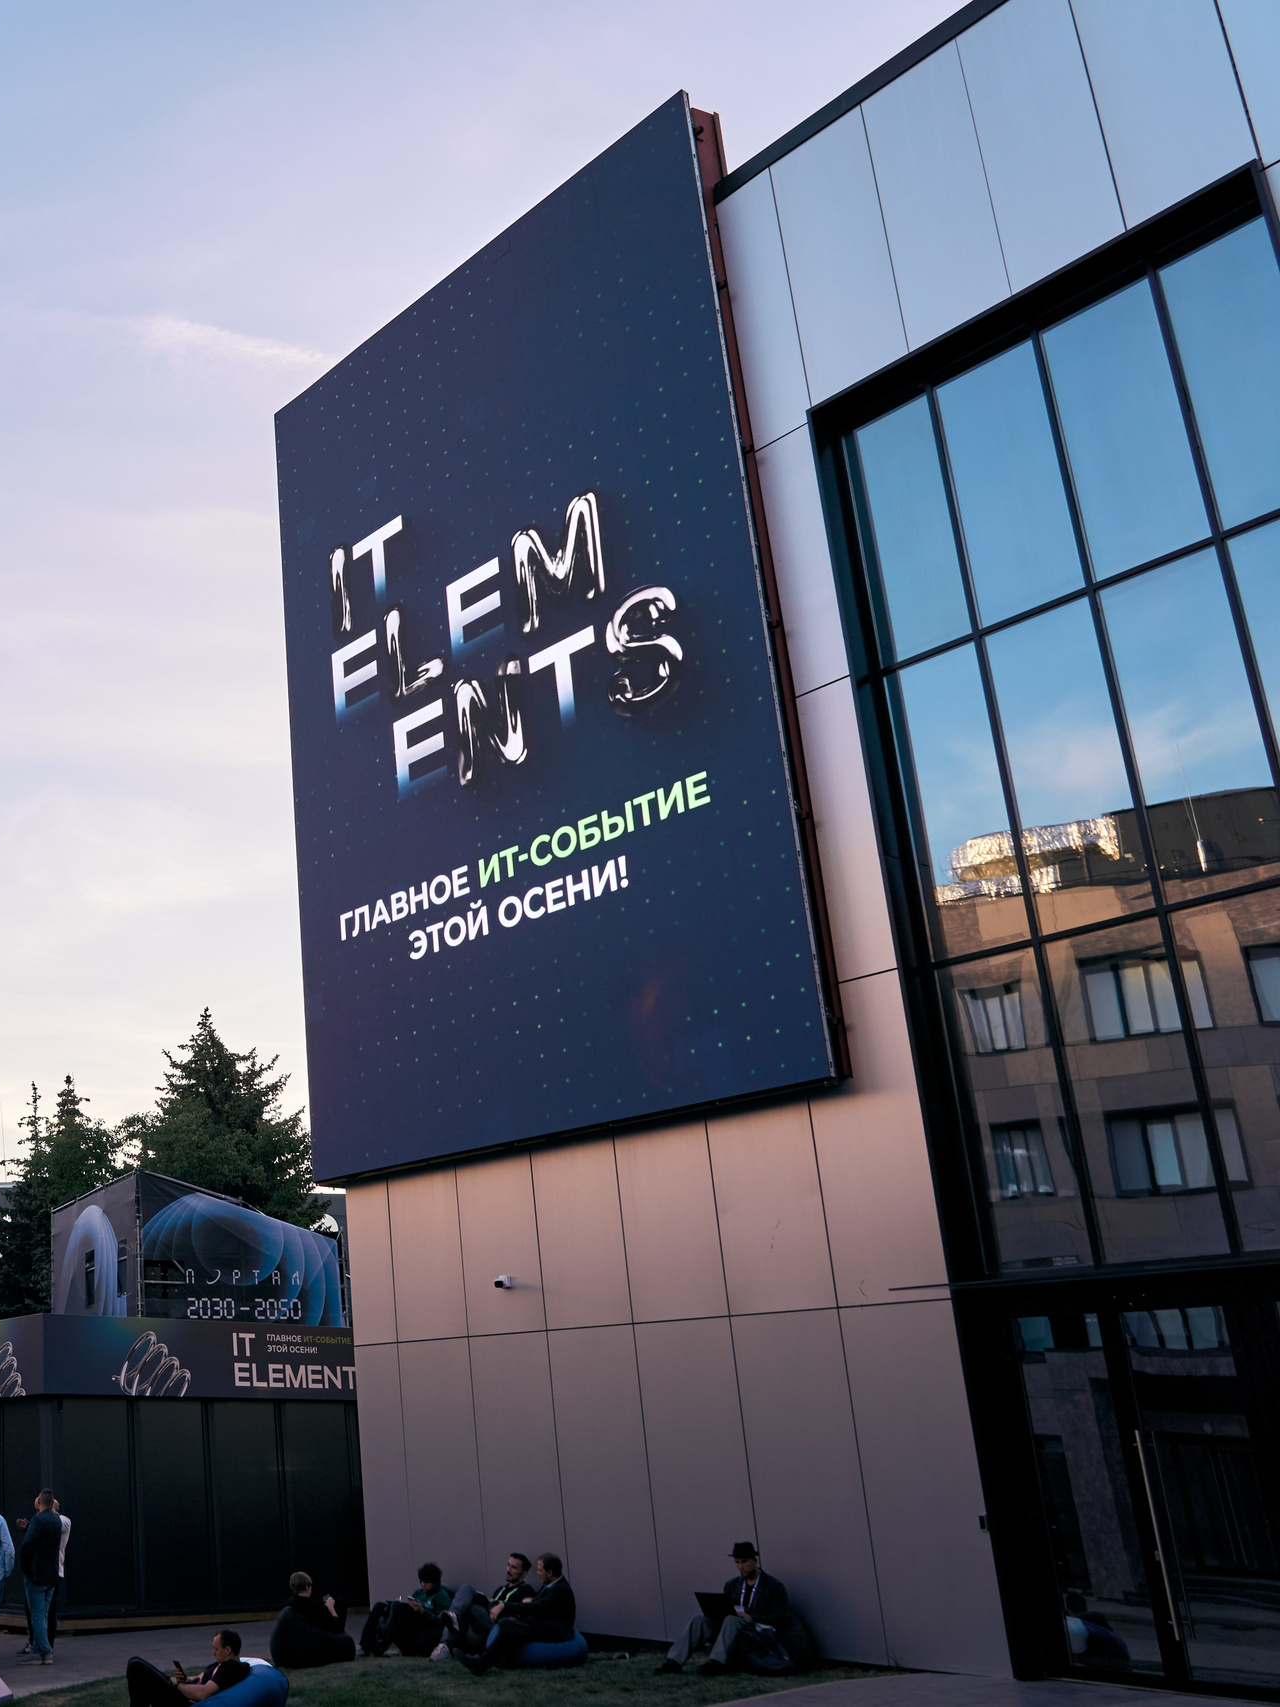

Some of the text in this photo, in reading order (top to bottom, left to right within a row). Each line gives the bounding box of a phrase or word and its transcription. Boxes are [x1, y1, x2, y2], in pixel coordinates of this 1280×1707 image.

[328, 513, 404, 634] IT
[330, 489, 607, 722] ELEM
[391, 583, 684, 792] ENTS
[339, 771, 712, 941] ГЛАВНОЕ ИТ-СОБЫТИЕ
[408, 856, 630, 961] ЭТОЙ ОСЕНИ!
[232, 1332, 256, 1357] IT
[266, 1333, 352, 1345] ГЛАВНОЕ ИТ-СОБЫТИЕ
[266, 1344, 318, 1354] ЭТОЙ ОСЕНИ!
